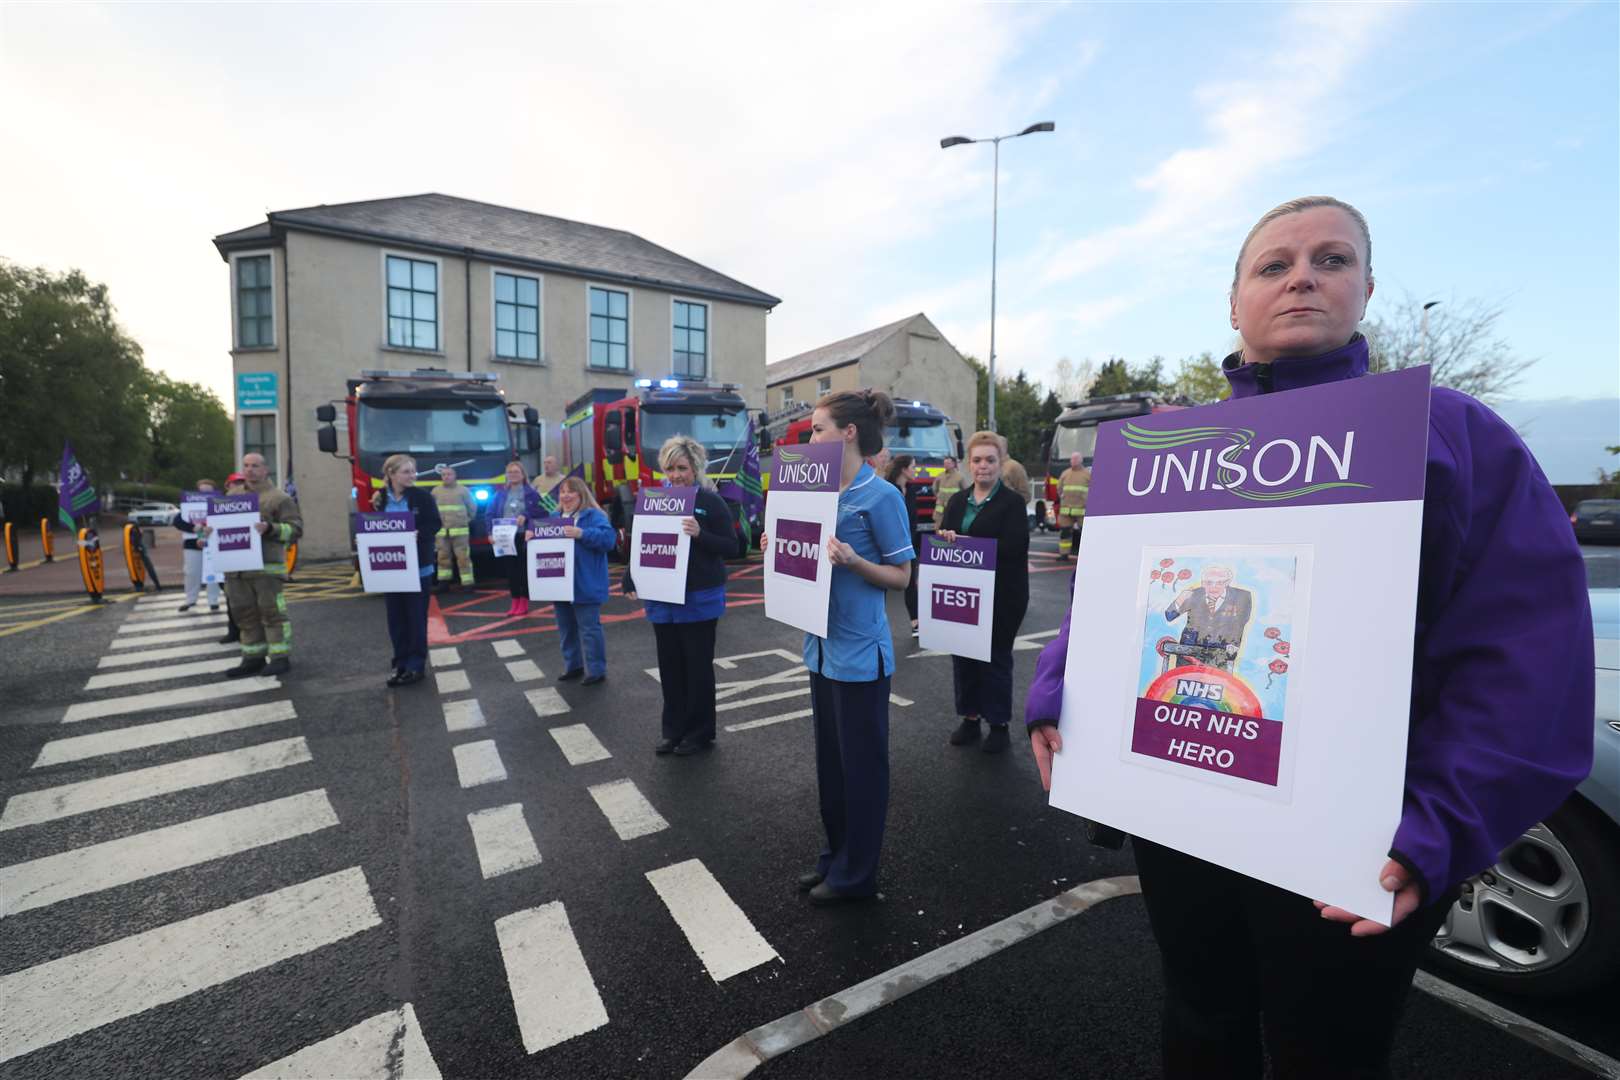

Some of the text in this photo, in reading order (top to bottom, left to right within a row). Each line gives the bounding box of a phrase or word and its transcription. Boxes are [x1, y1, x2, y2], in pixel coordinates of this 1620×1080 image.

[779, 463, 829, 484] UNISON
[1126, 430, 1355, 497] UNISON
[213, 501, 252, 513] UNISON
[643, 498, 686, 512] UNISON
[364, 519, 406, 531] UNISON
[369, 551, 406, 563] 100th
[640, 543, 678, 556] CAPTAIN
[775, 538, 820, 560] TOM
[930, 547, 984, 565] UNISON
[932, 587, 980, 609] TEST
[1177, 679, 1222, 700] NHS
[1154, 705, 1260, 741] OUR NHS
[1167, 738, 1234, 770] HERO
